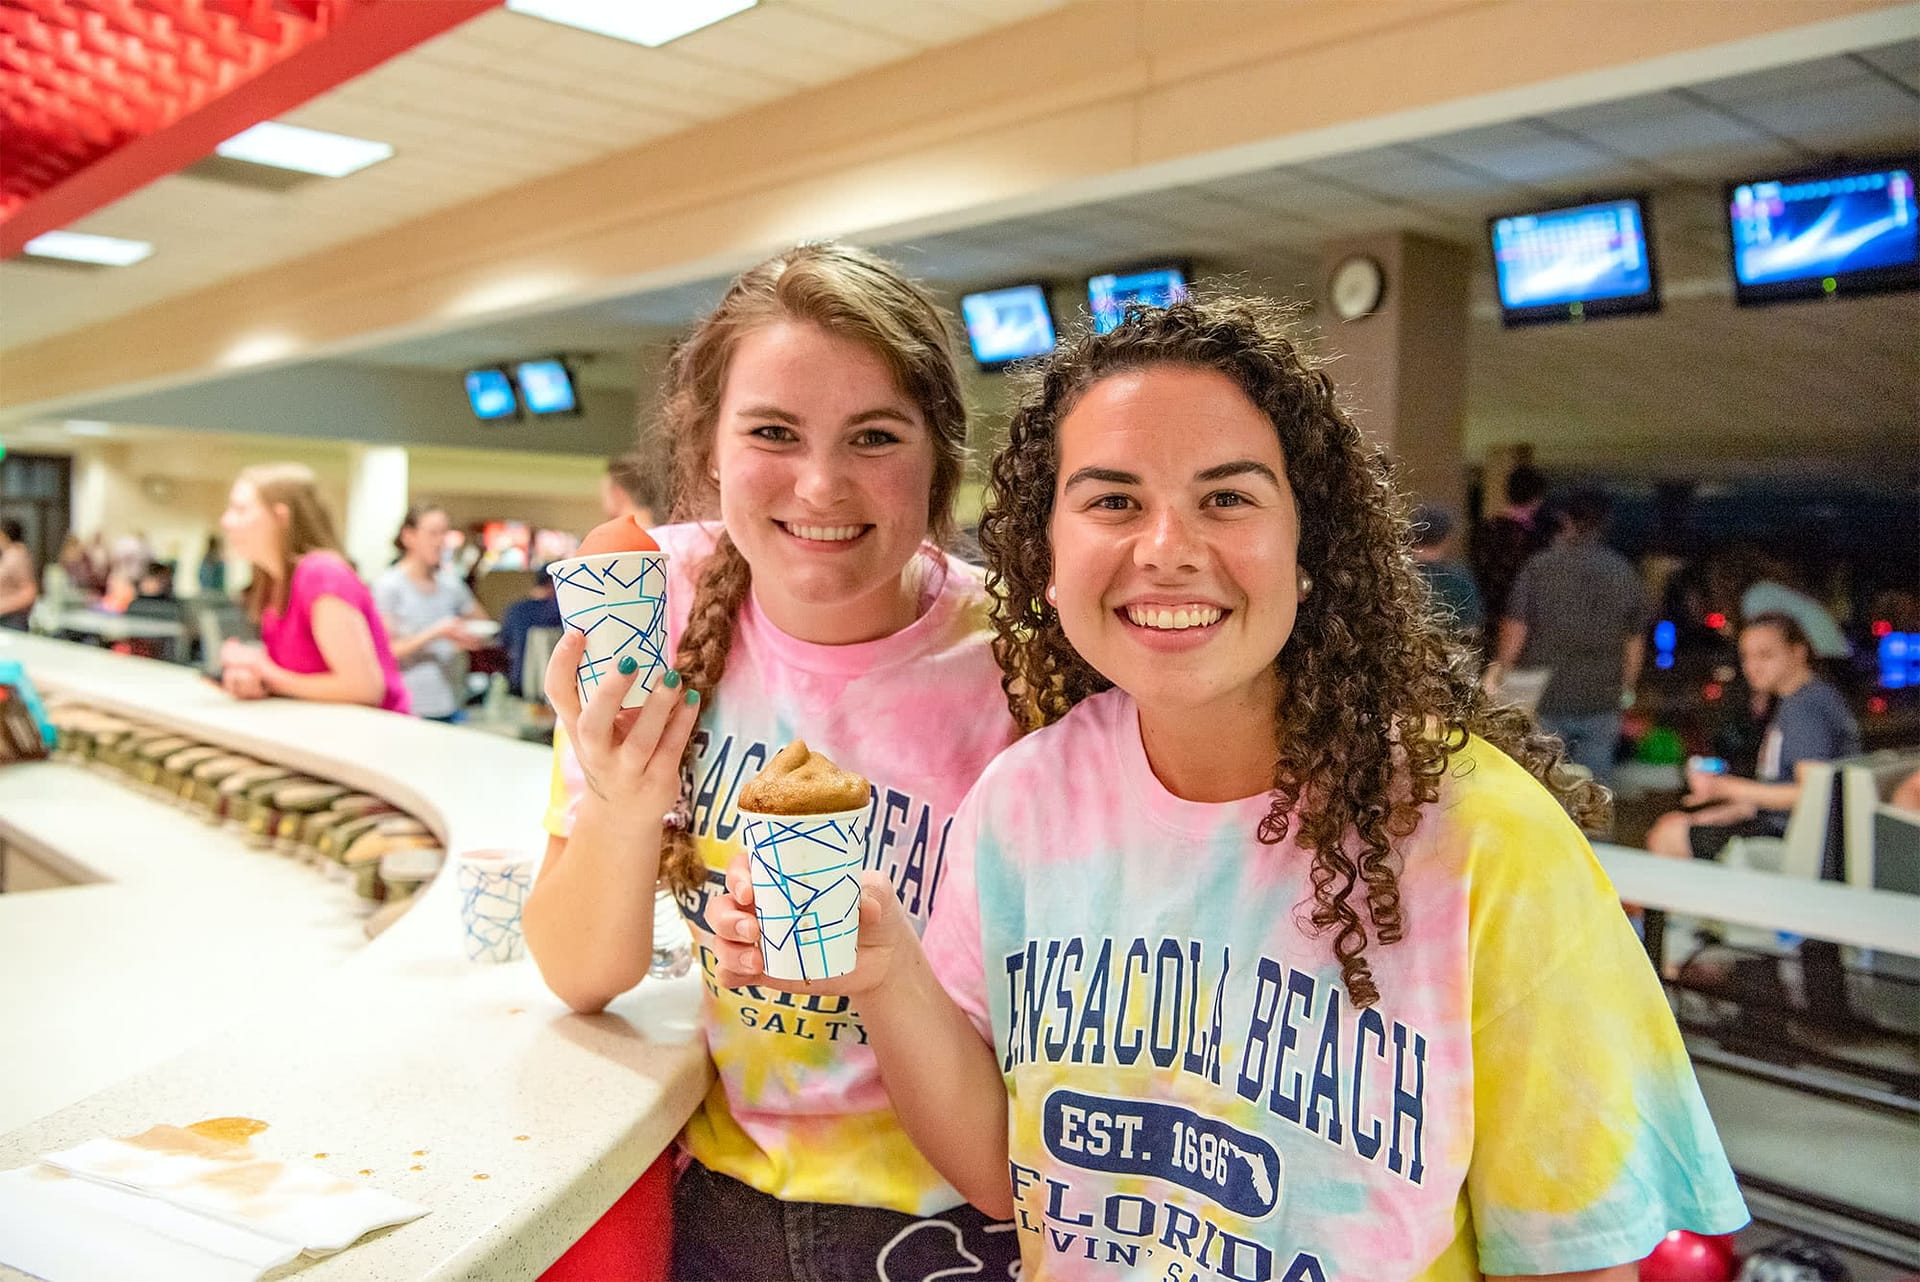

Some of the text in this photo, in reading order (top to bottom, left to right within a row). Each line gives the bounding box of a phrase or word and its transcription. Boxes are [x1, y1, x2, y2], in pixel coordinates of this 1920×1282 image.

[739, 1006, 869, 1046] SALTY
[1236, 956, 1427, 1185] BEACH
[1058, 1103, 1229, 1187] EST. 1686
[1009, 1159, 1327, 1282] FLORIDA
